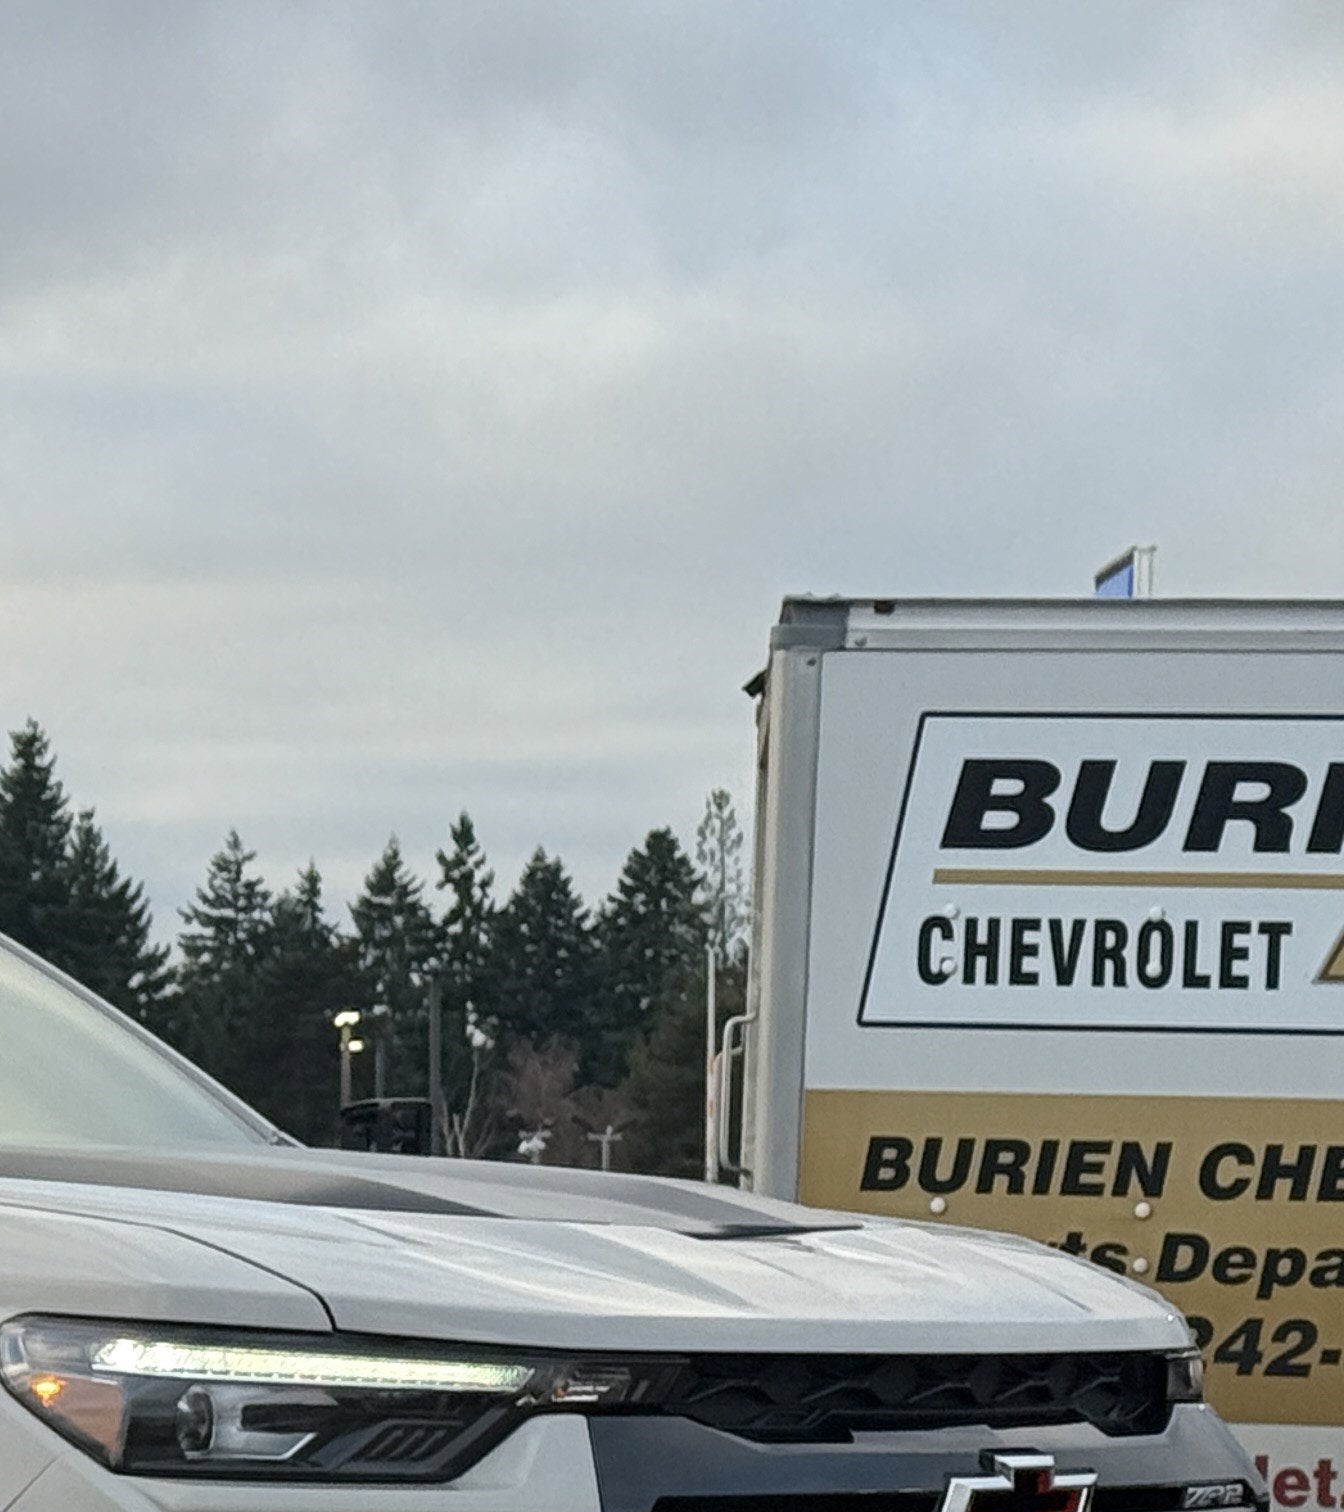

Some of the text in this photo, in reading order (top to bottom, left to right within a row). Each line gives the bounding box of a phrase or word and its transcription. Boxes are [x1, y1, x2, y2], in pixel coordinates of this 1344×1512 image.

[939, 759, 1344, 854] BURI
[916, 915, 1293, 991] CHEVROLET
[859, 1135, 1173, 1198] BURIEN
[1154, 1231, 1344, 1300] Depa
[1183, 1483, 1244, 1509] ZR2
